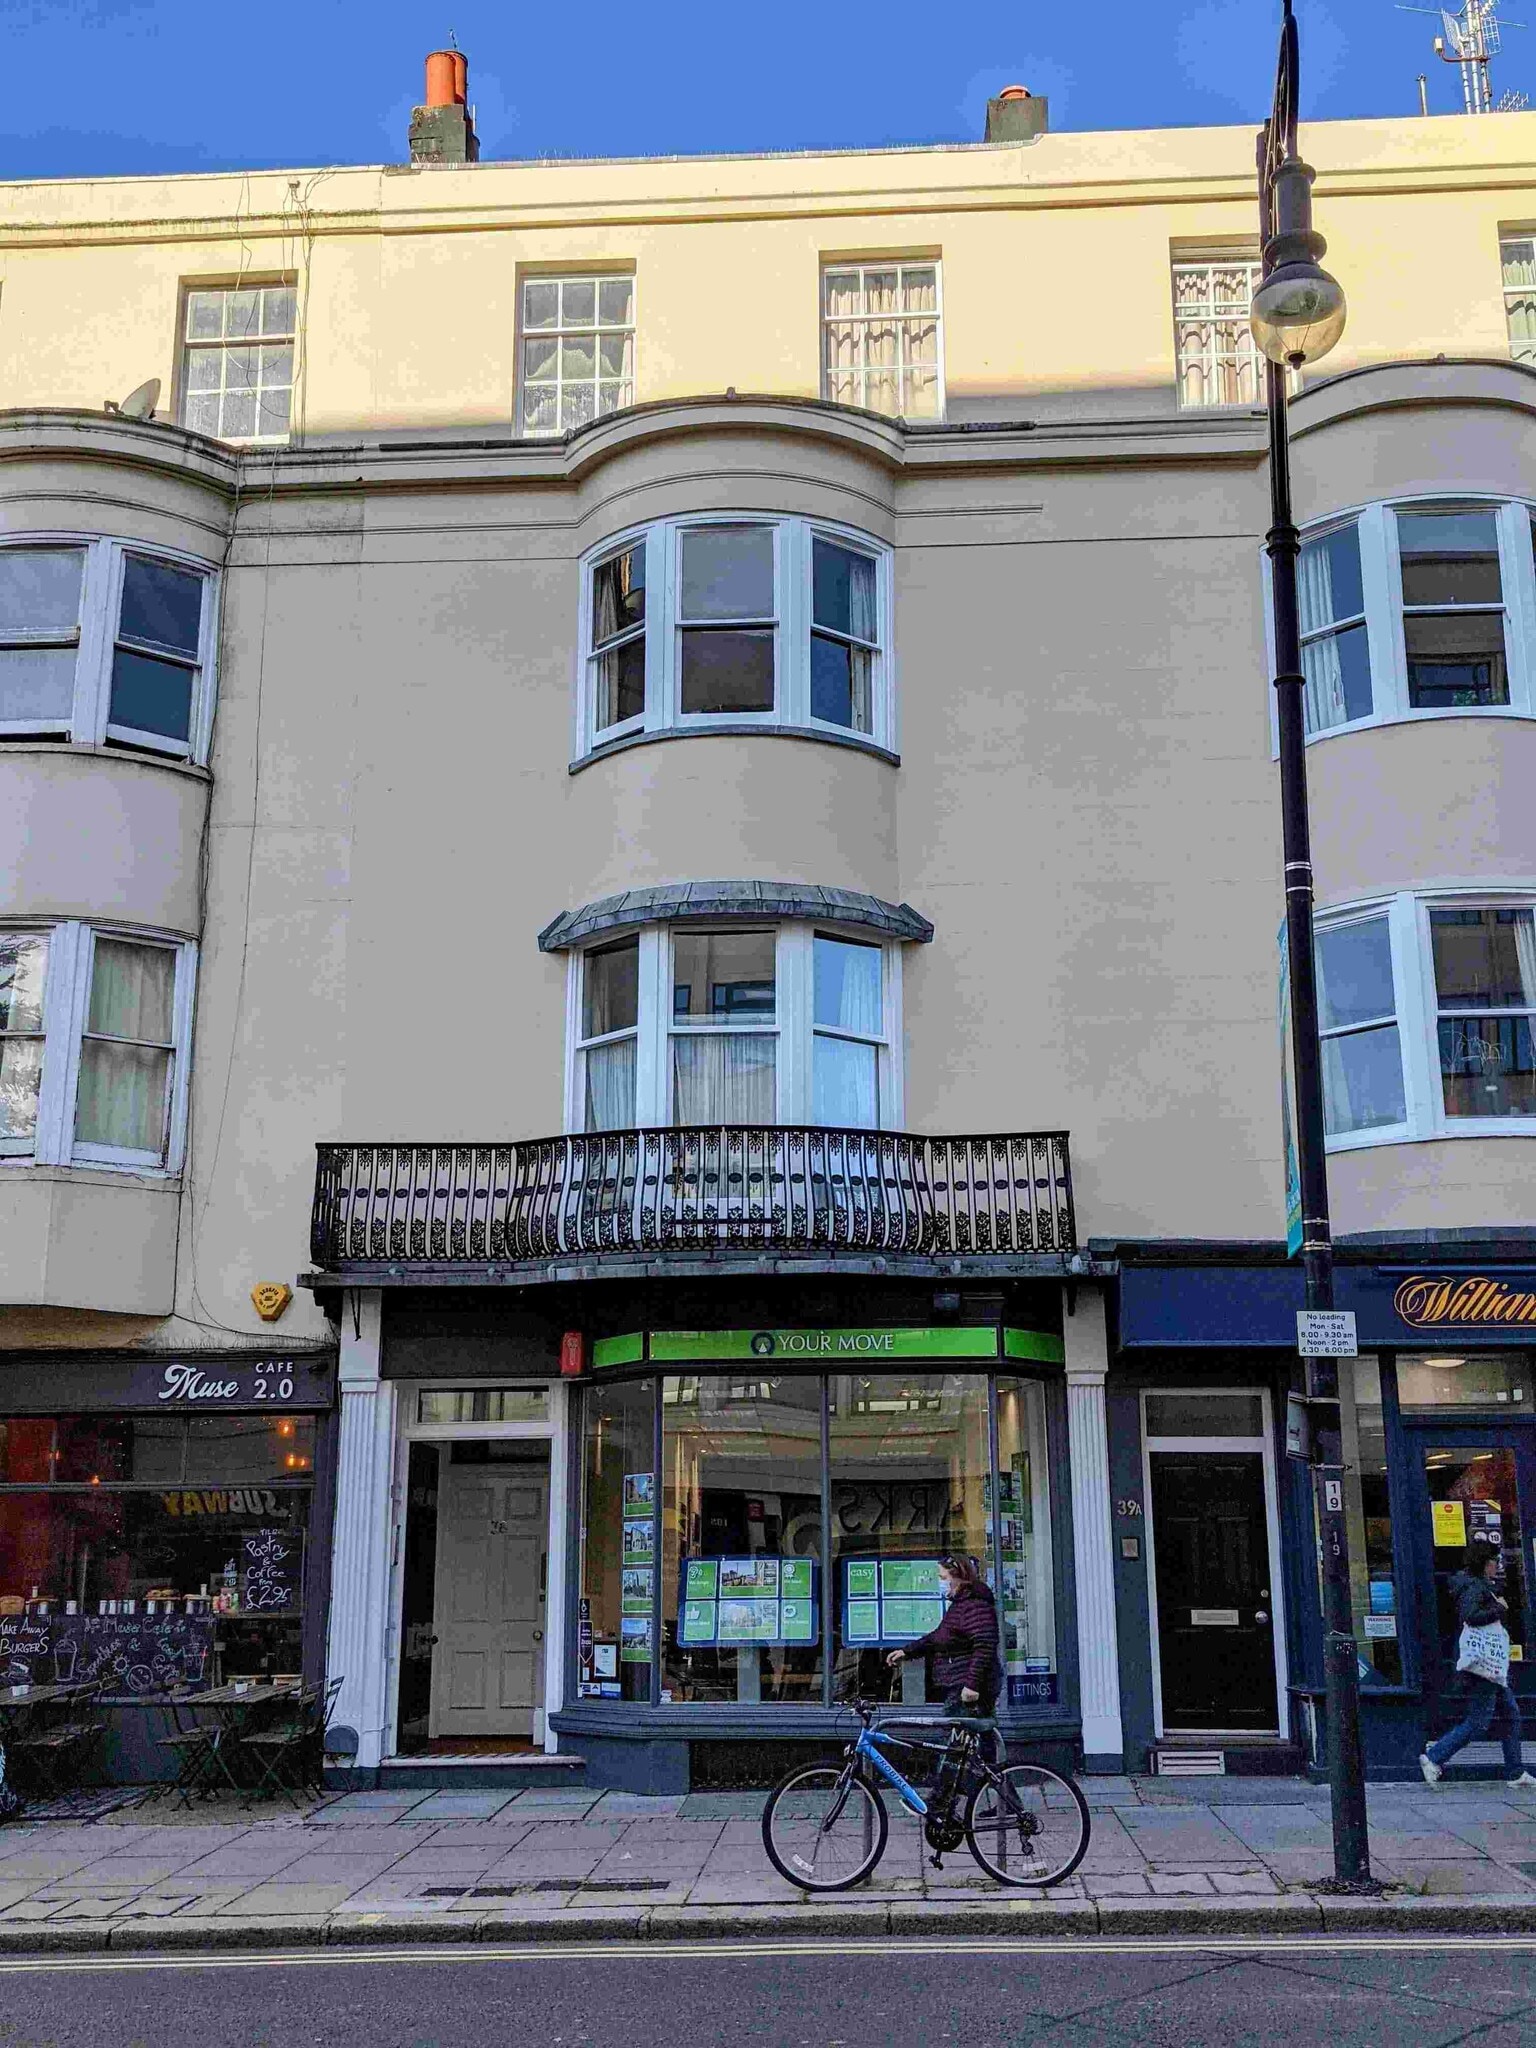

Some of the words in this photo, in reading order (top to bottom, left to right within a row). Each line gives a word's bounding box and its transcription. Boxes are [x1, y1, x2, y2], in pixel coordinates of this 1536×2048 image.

[778, 1335, 832, 1351] YOUR
[838, 1334, 895, 1351] MOVE
[255, 1362, 294, 1373] CAFE
[158, 1364, 240, 1400] Muse
[253, 1378, 294, 1399] 2.0
[1117, 1499, 1143, 1516] 39A
[246, 1536, 290, 1560] Pastry
[246, 1566, 287, 1580] Coffee
[850, 1567, 875, 1580] easy
[0, 1636, 50, 1657] BURGERS
[1012, 1682, 1052, 1697] LETTINGS
